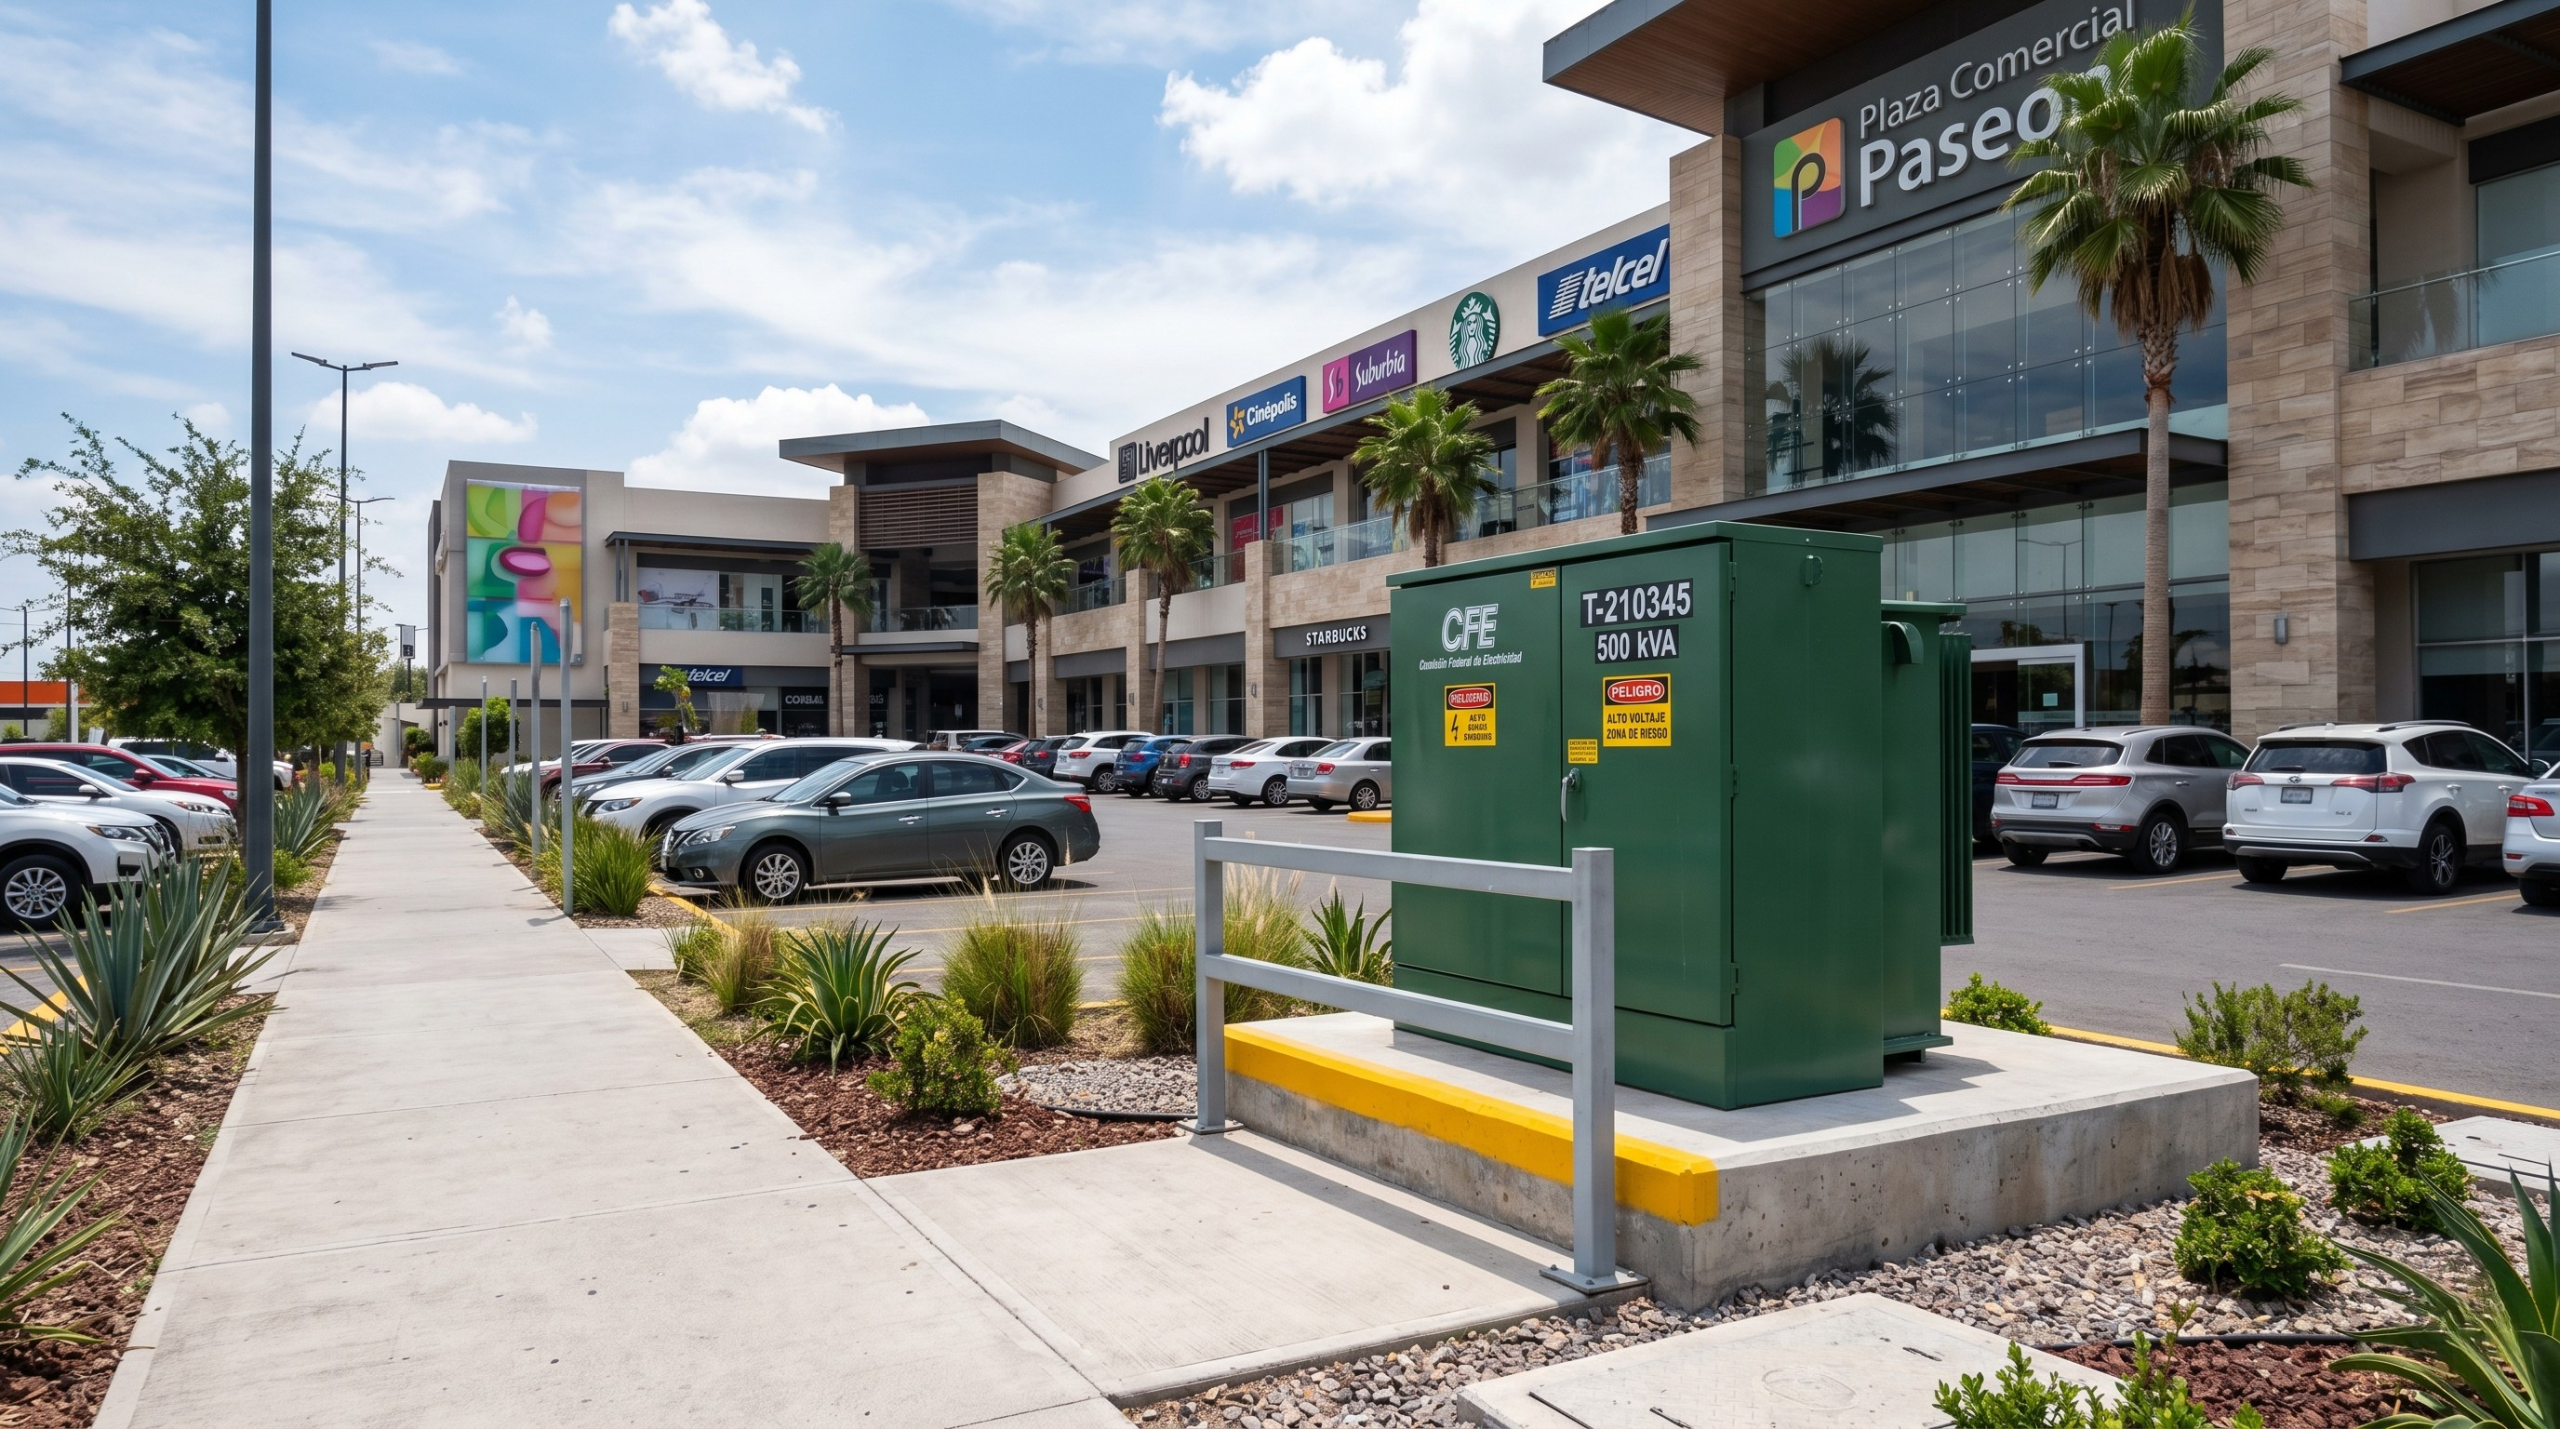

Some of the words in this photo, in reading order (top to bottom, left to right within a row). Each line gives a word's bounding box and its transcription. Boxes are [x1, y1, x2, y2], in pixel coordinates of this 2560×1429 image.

[1860, 84, 1942, 139] Plaza
[1950, 0, 2134, 99] Comercial
[1579, 238, 1669, 310] telcel
[1355, 349, 1405, 393] Suburbia
[1247, 392, 1298, 426] Cinépolis
[1138, 416, 1210, 476] Liverpool
[1583, 582, 1691, 625] T-210345
[1306, 625, 1367, 647] STARBUCKS
[1442, 604, 1499, 653] CFE
[1597, 632, 1630, 662] 500
[1637, 628, 1677, 659] kVA
[687, 668, 732, 683] telcel
[1473, 655, 1482, 667] de
[1611, 684, 1661, 699] PELIGRO
[1607, 713, 1628, 724] ALTO
[1630, 712, 1666, 724] VOLTAJE
[1628, 728, 1639, 739] DE
[1640, 727, 1668, 739] RIESGO
